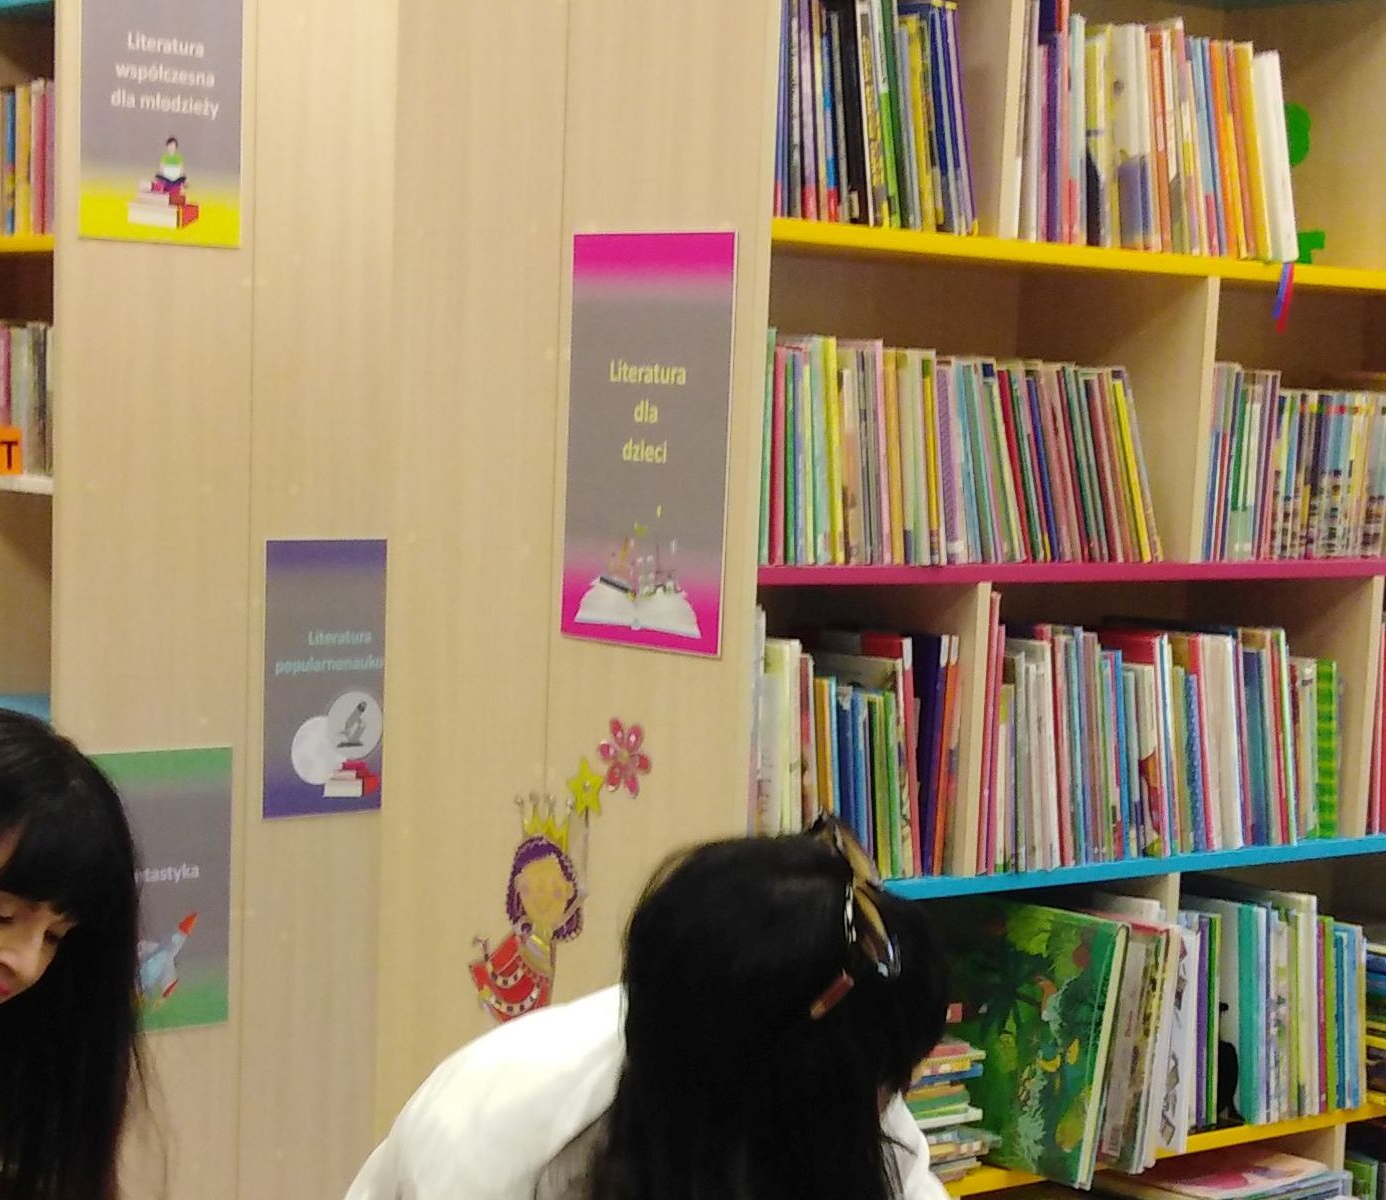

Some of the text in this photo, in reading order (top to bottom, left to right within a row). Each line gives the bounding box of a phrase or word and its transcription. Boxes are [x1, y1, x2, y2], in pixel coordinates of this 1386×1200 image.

[126, 30, 205, 58] Literatura
[115, 62, 215, 88] współczesna
[111, 88, 219, 121] dla młodzieży
[609, 359, 687, 385] Literatura
[633, 398, 659, 424] dla
[0, 440, 18, 470] T
[621, 437, 667, 464] dzieci
[308, 629, 373, 646] Literatura
